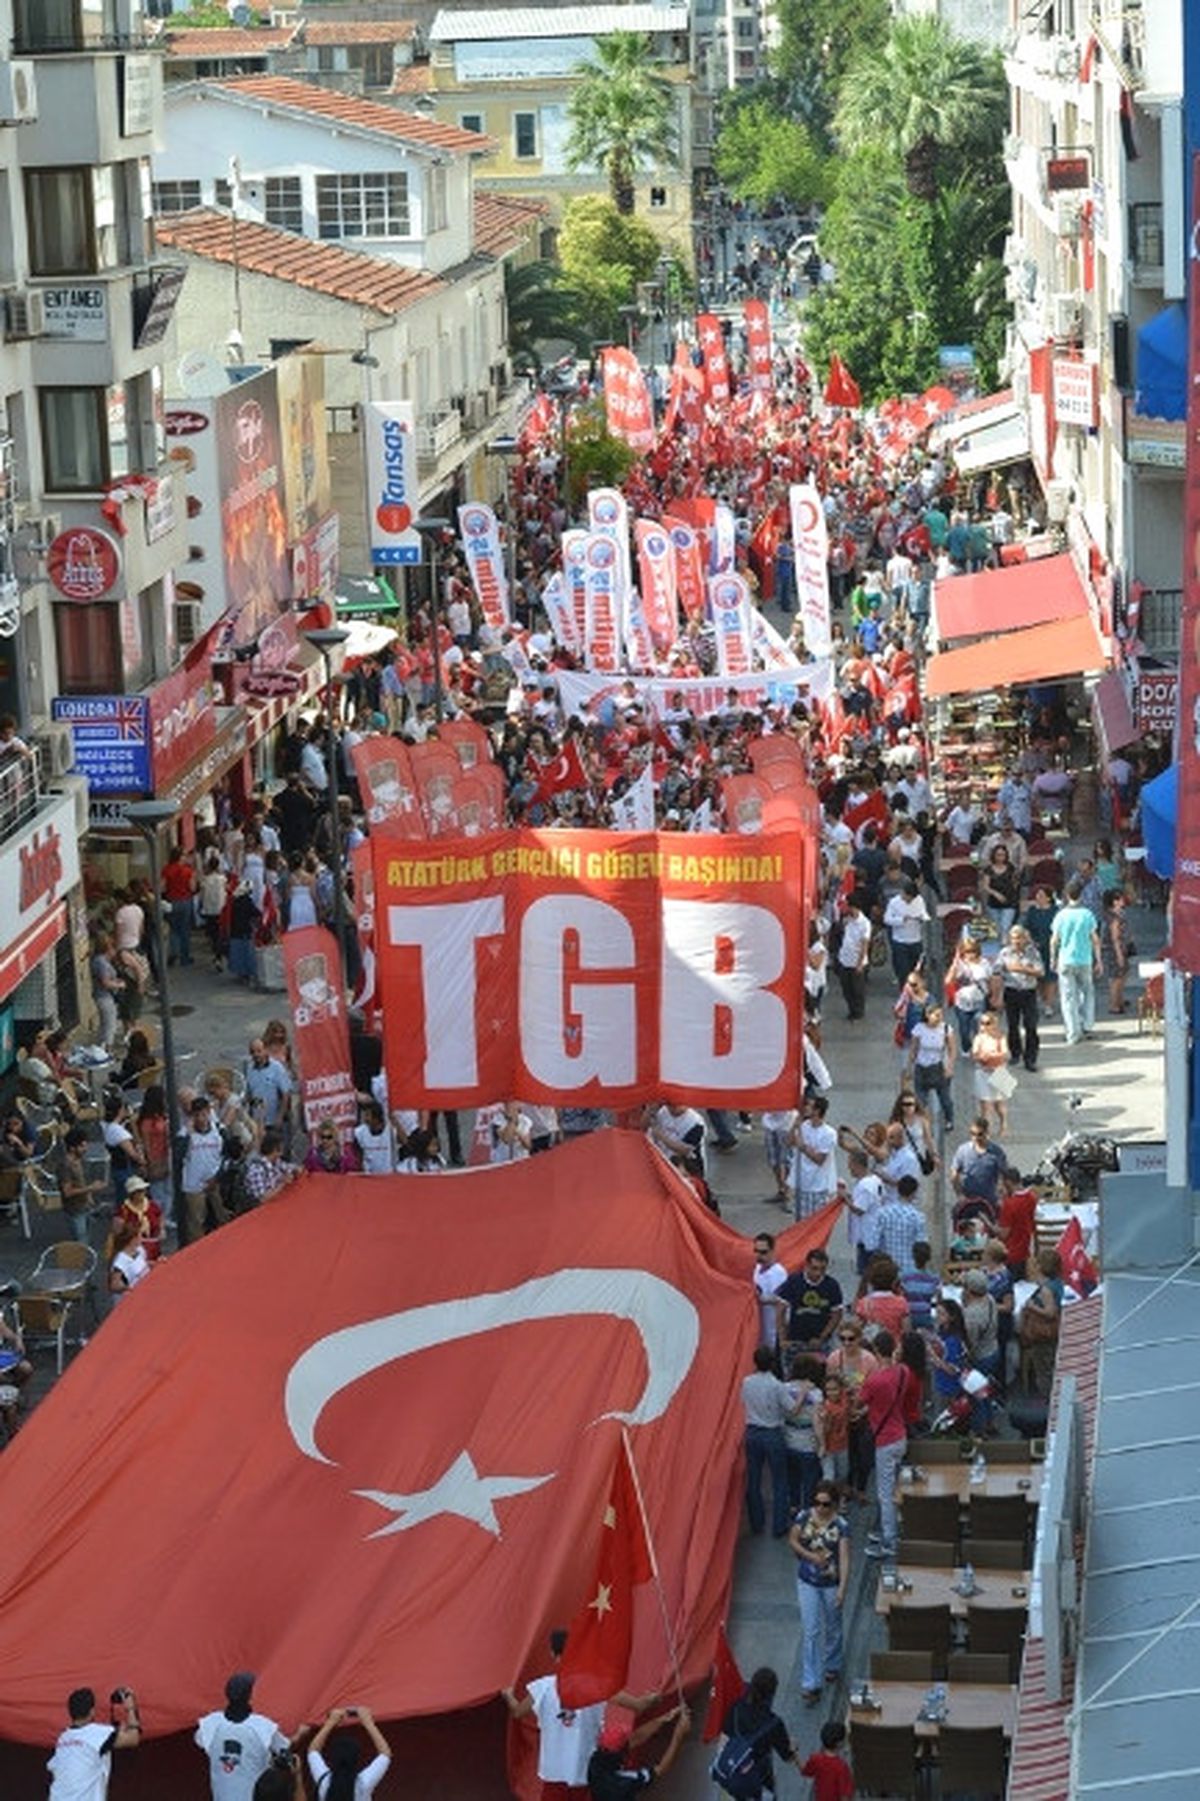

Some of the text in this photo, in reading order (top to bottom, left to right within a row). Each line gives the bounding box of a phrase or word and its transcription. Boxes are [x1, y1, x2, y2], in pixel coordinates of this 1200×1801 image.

[387, 847, 783, 887] ATATÜRK GENÇLİĞİ GÖREV BAŞINDA!
[387, 893, 789, 1091] TGB
